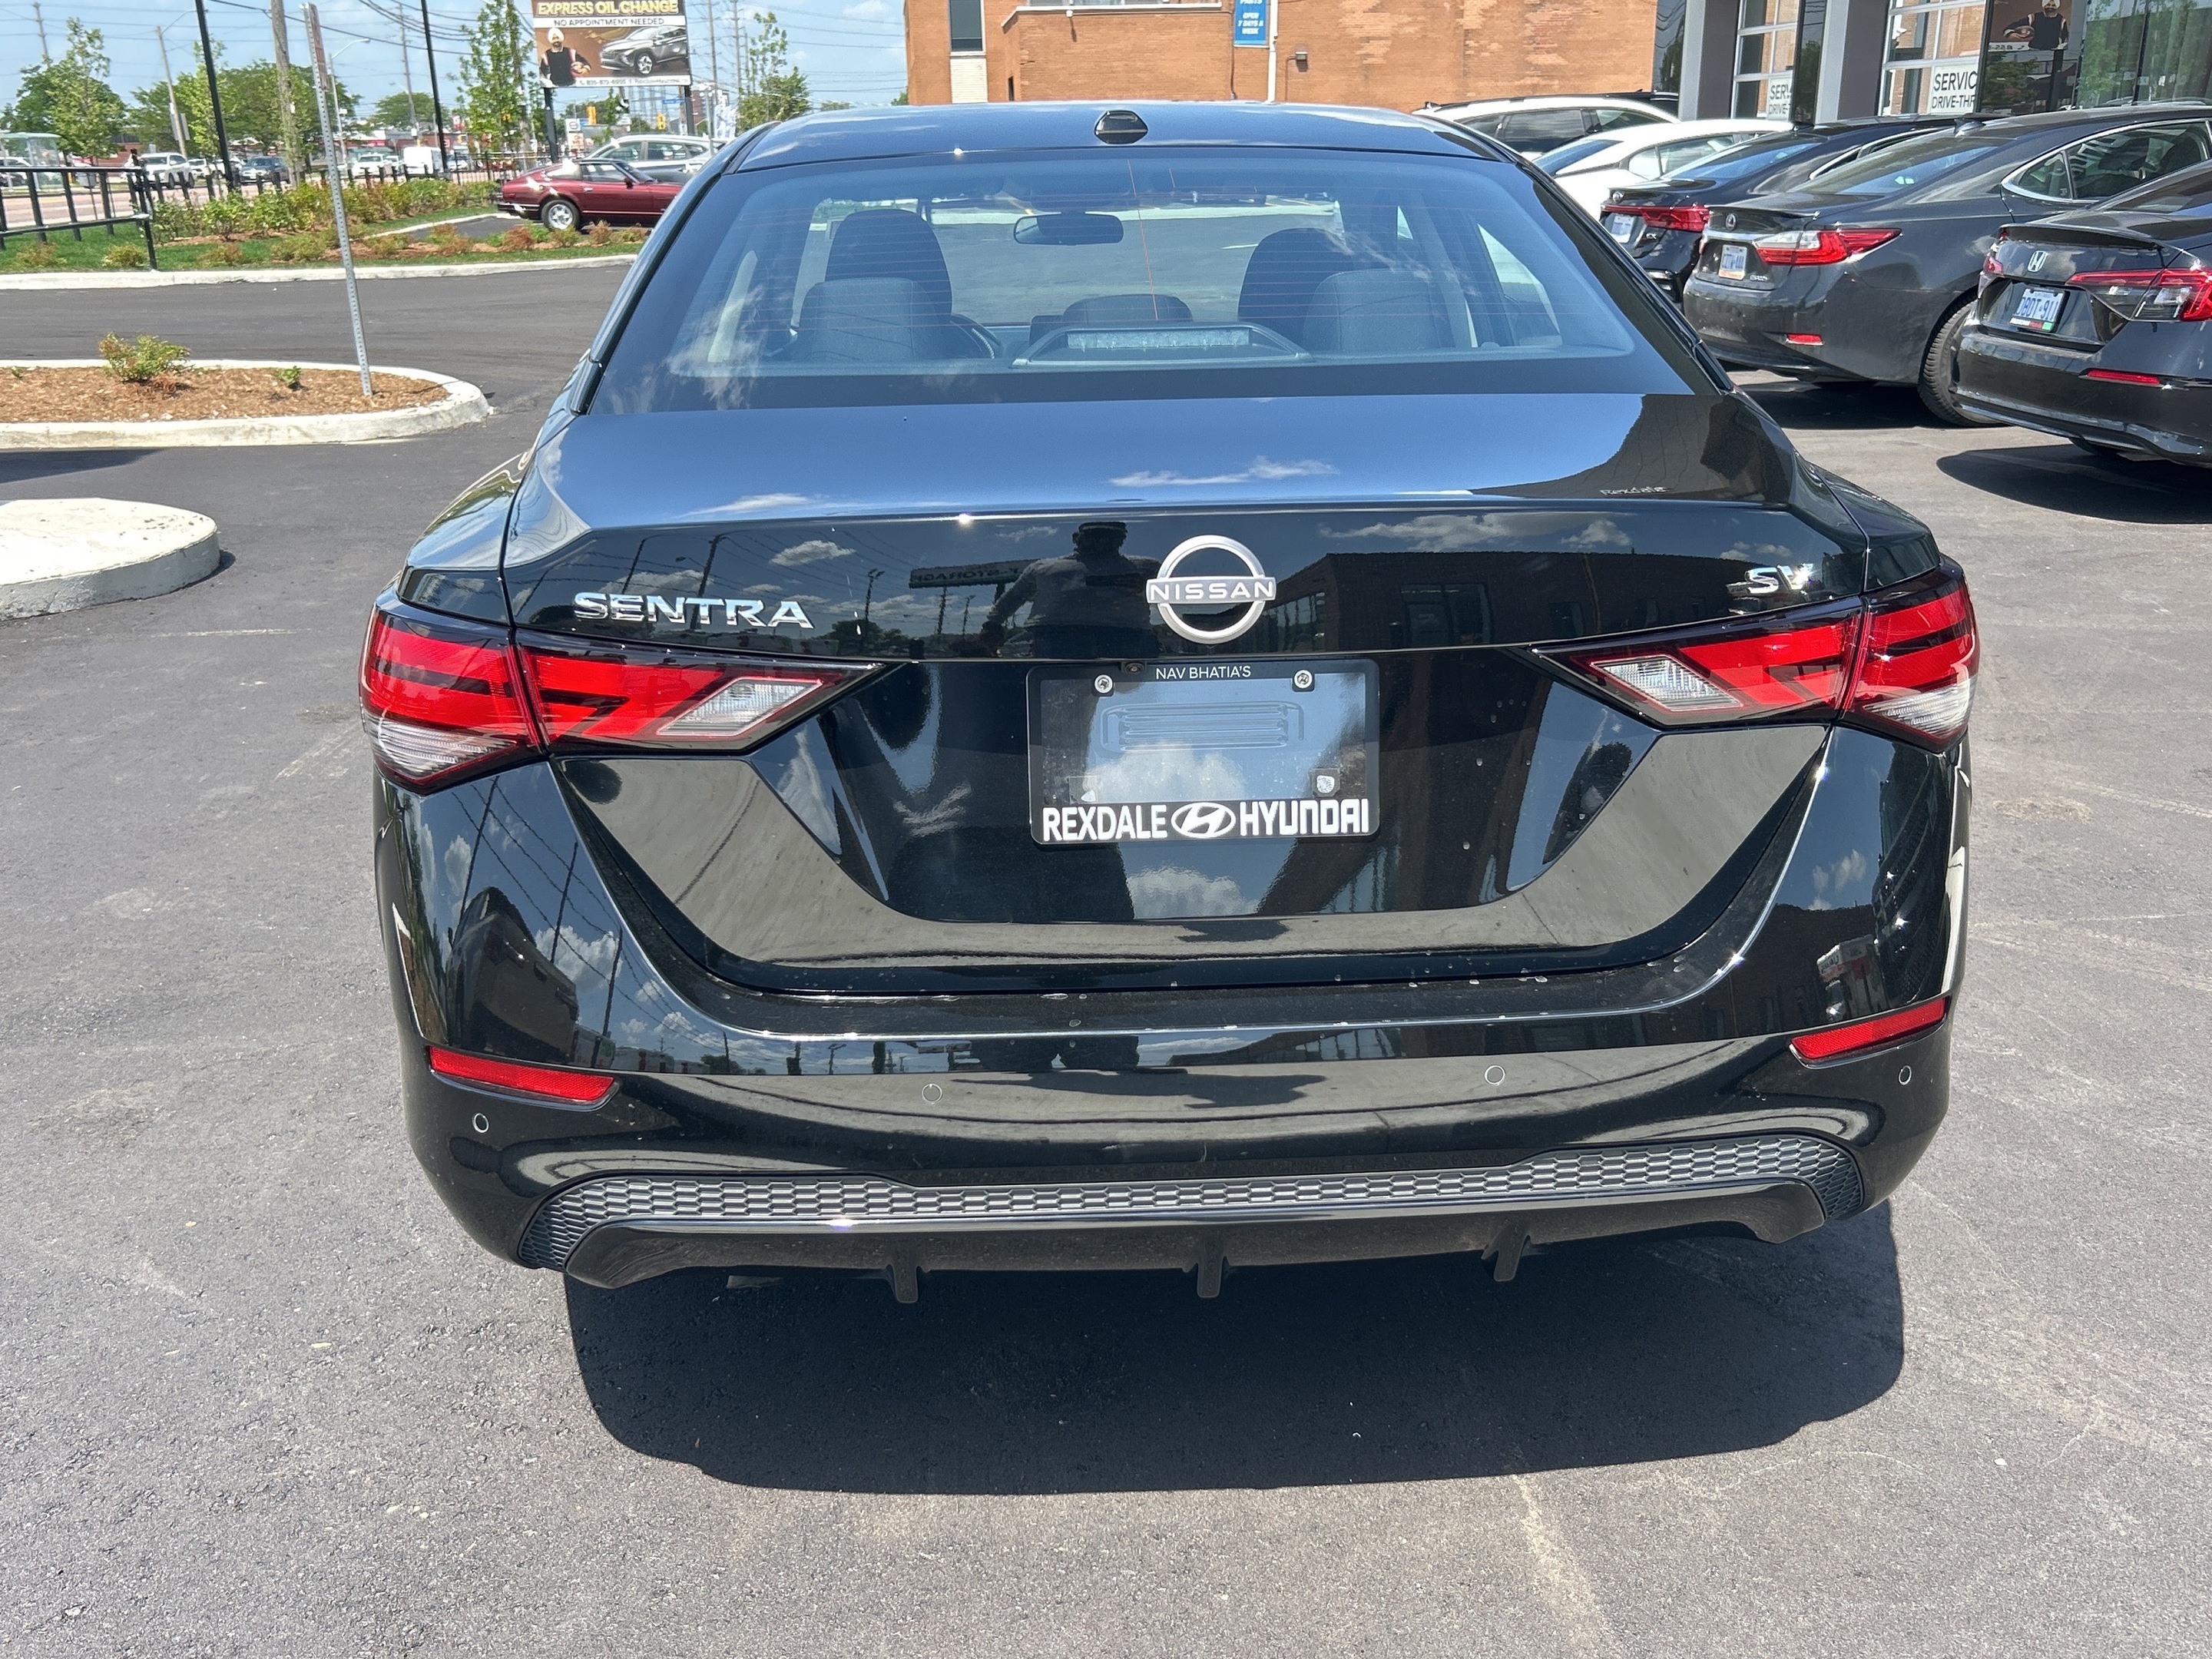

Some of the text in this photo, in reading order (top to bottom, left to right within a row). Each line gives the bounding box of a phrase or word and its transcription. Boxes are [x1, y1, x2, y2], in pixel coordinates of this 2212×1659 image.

[538, 0, 679, 15] EXPRESS OIL CHANGE
[1150, 581, 1273, 601] NISSAN
[1745, 563, 1815, 594] SV
[574, 592, 814, 628] SENTRA
[1156, 665, 1252, 680] NAV BHATIA'S
[1042, 798, 1369, 841] REXDALE HYUNDAI
